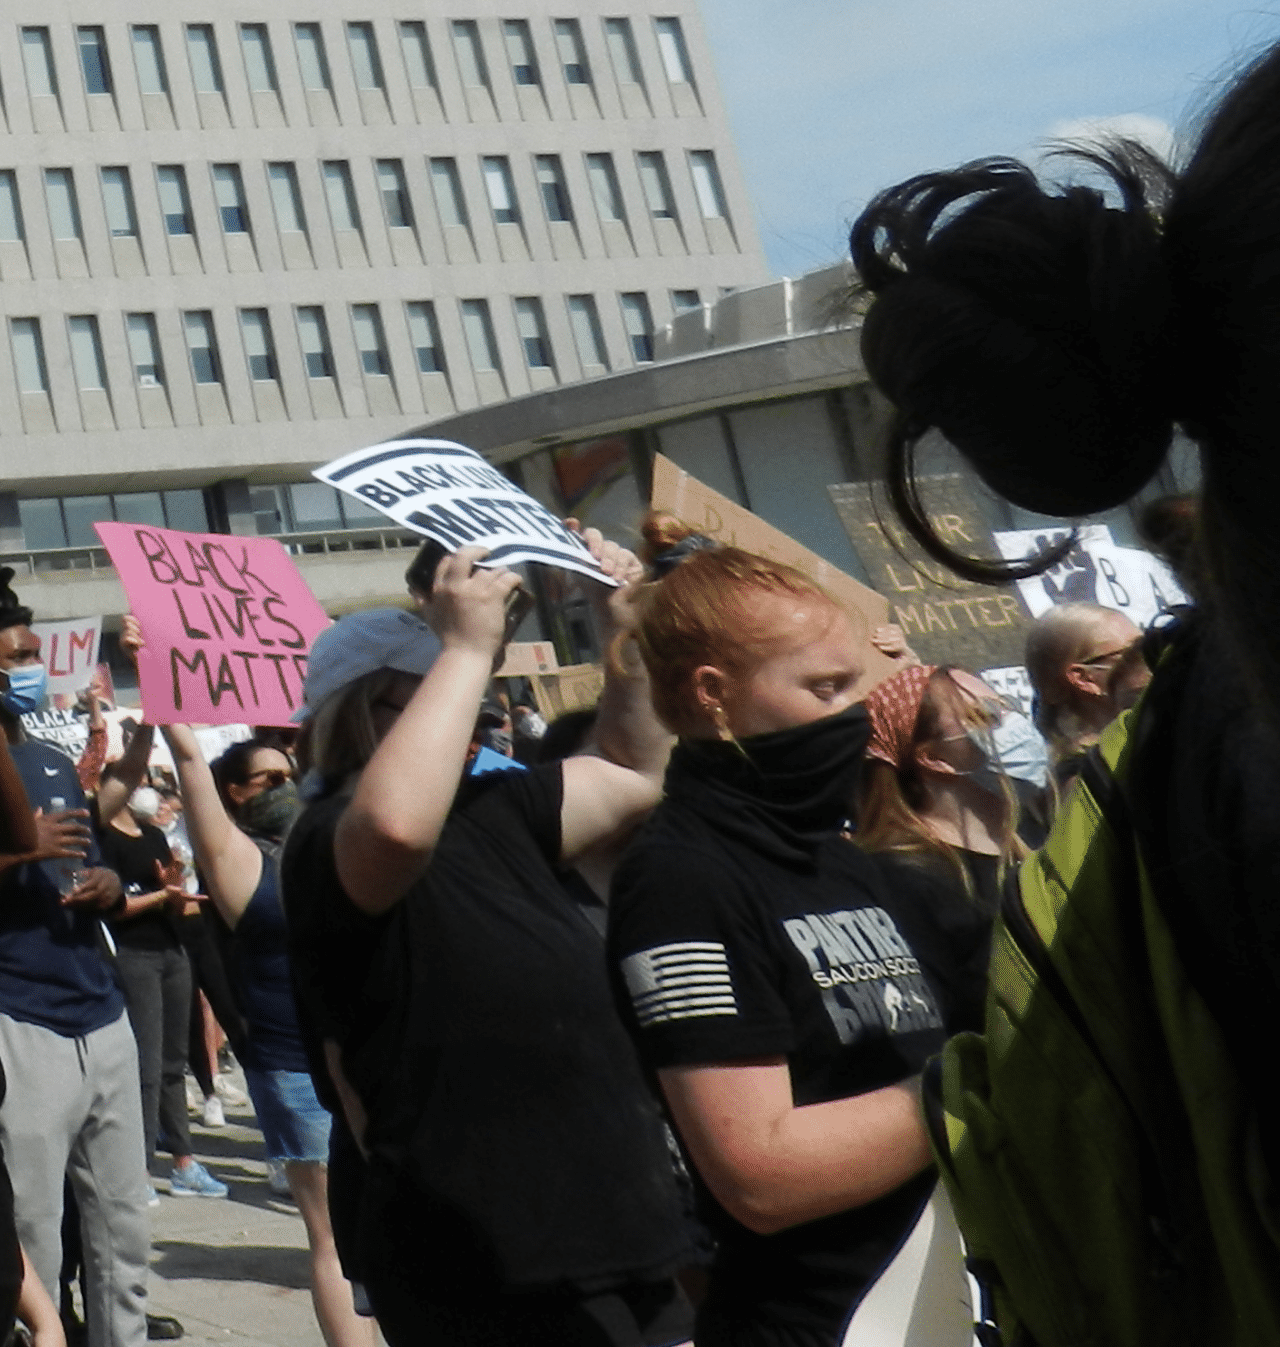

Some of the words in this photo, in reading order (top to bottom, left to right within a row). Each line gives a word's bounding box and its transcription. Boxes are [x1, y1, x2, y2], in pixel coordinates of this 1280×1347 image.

[354, 462, 461, 509] BLACK
[134, 529, 282, 599] BLACK
[171, 587, 307, 650] LIVES
[894, 594, 1019, 635] MATTER
[19, 709, 77, 729] BLACK
[811, 961, 888, 989] SAUCON
